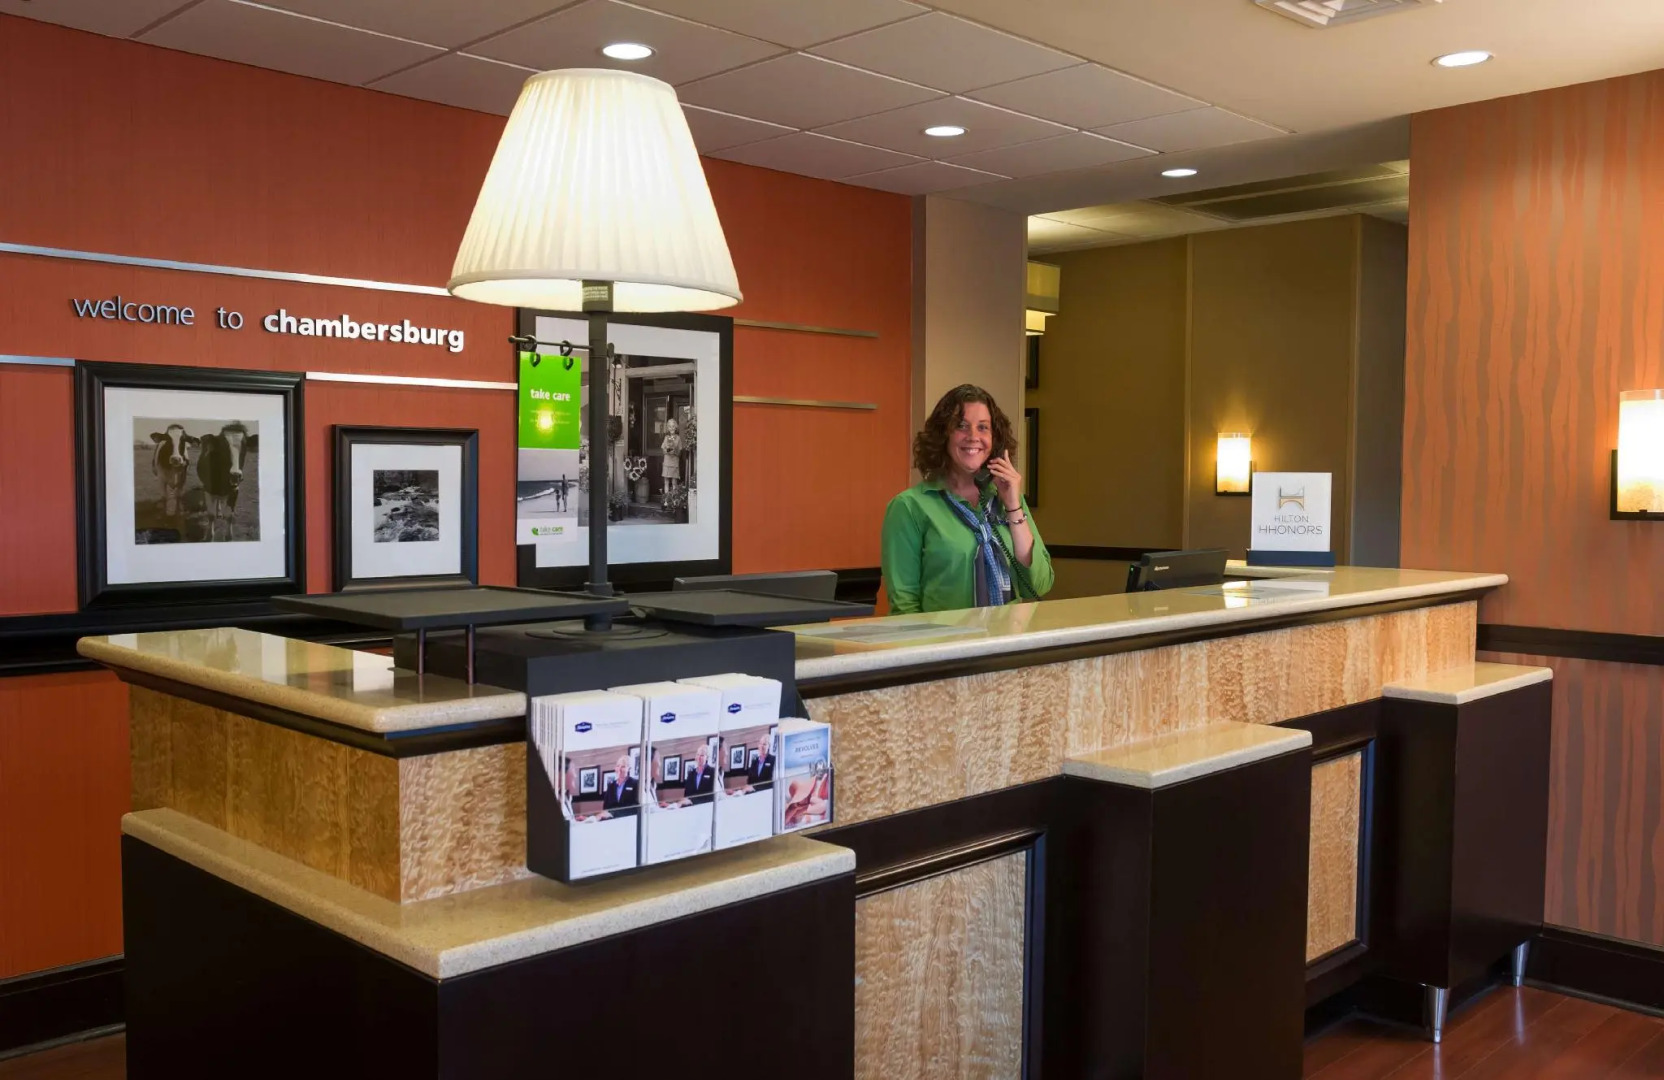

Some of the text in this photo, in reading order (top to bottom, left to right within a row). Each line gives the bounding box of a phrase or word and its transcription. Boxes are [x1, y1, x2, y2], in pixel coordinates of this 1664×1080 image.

[73, 295, 465, 353] welcome to chambersburg
[530, 388, 571, 402] take care
[1274, 514, 1309, 523] HILTON
[1259, 525, 1323, 535] HHONORS
